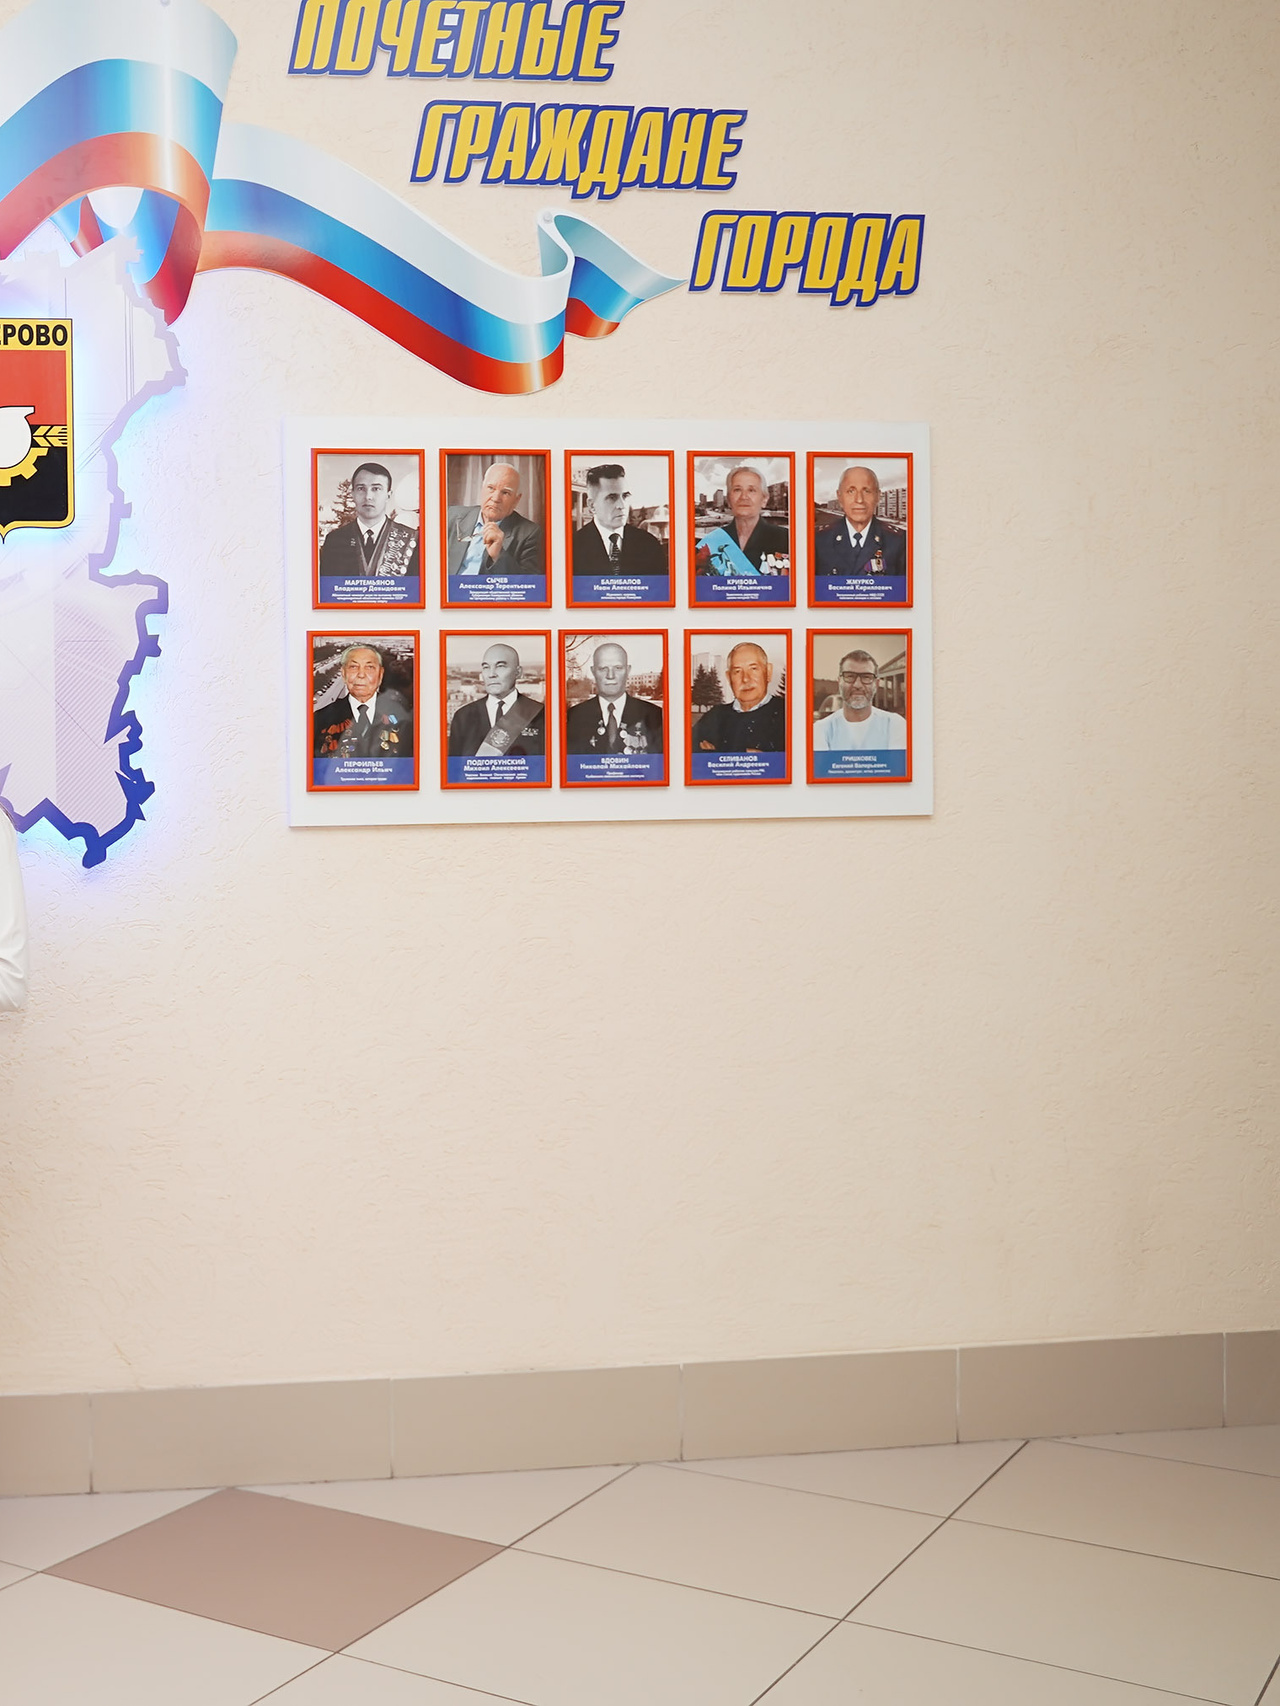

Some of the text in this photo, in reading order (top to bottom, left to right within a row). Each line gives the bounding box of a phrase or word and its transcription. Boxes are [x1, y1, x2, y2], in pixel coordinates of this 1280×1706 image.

[288, 0, 624, 82] ПОЧЕТНЫЕ
[410, 100, 748, 199] ГРАЖДАНЕ
[688, 209, 926, 307] ГОРОДА
[467, 758, 526, 766] ПОДГОРБУНСКИЙ
